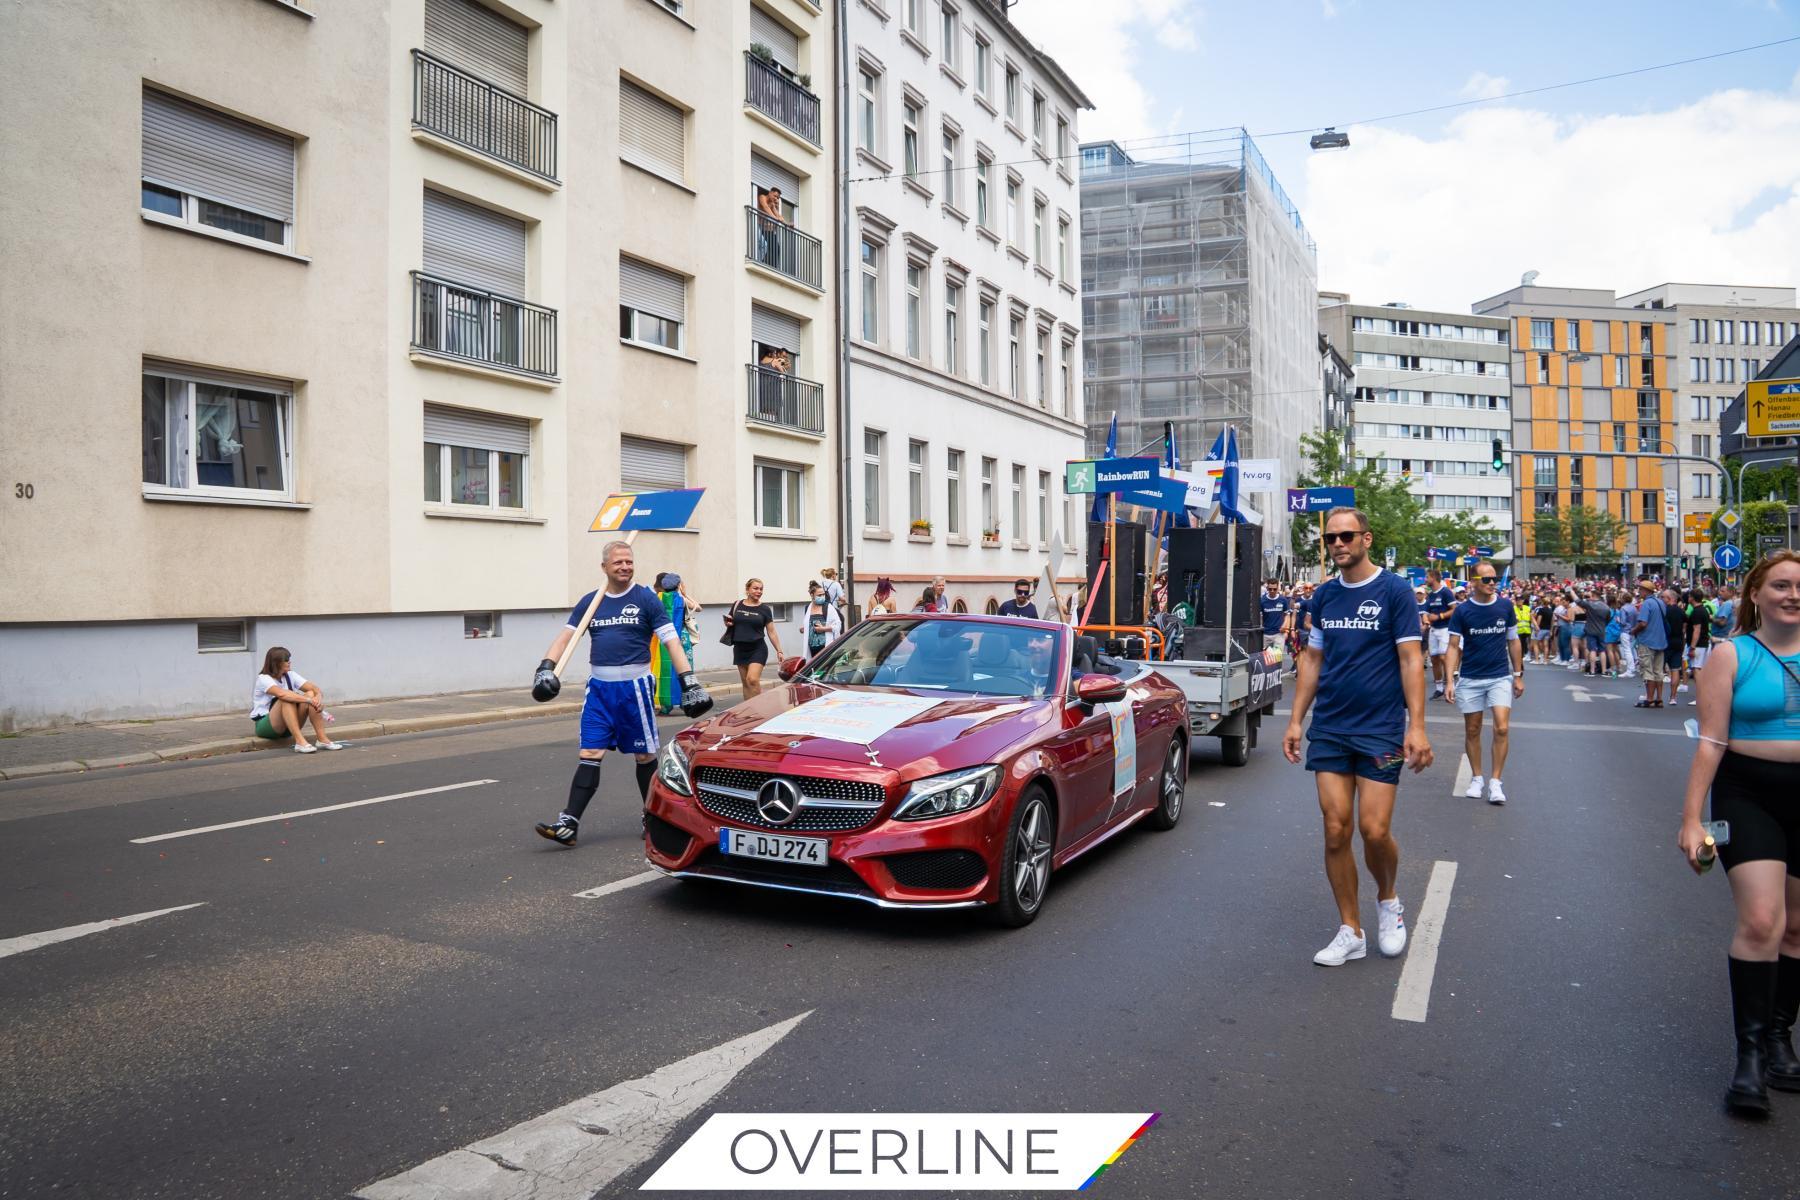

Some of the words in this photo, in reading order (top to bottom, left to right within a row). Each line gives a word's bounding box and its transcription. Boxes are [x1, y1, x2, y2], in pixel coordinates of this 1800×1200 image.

[1097, 470, 1150, 482] RainbowRUN
[1243, 471, 1272, 480] fvv.org
[15, 482, 34, 499] 30
[590, 616, 640, 628] Frankfurt
[1320, 616, 1380, 631] Frankfurt
[1470, 626, 1506, 635] Frankfurt
[736, 834, 746, 852] F
[784, 840, 818, 861] 274
